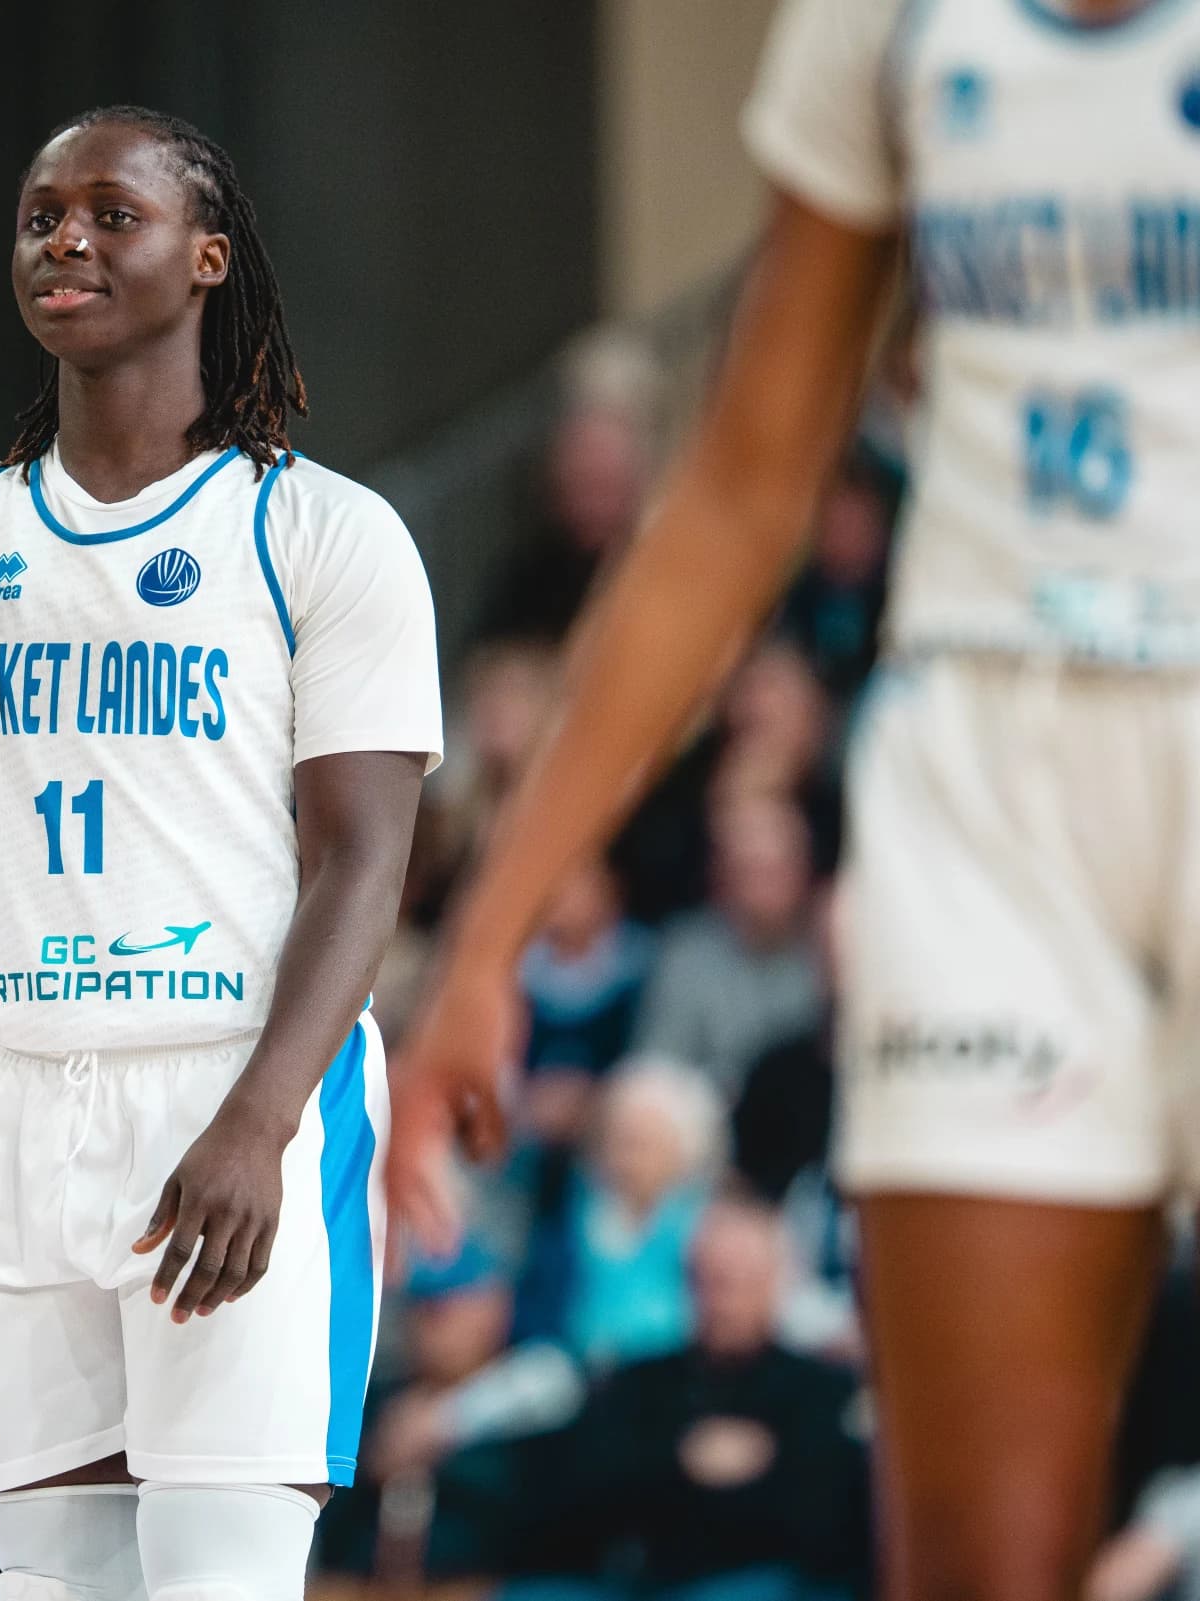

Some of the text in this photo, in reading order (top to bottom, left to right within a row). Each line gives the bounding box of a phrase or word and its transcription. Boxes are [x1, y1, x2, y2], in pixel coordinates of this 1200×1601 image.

[76, 641, 229, 742] LANDES
[34, 780, 104, 875] 11
[40, 935, 97, 965] GC
